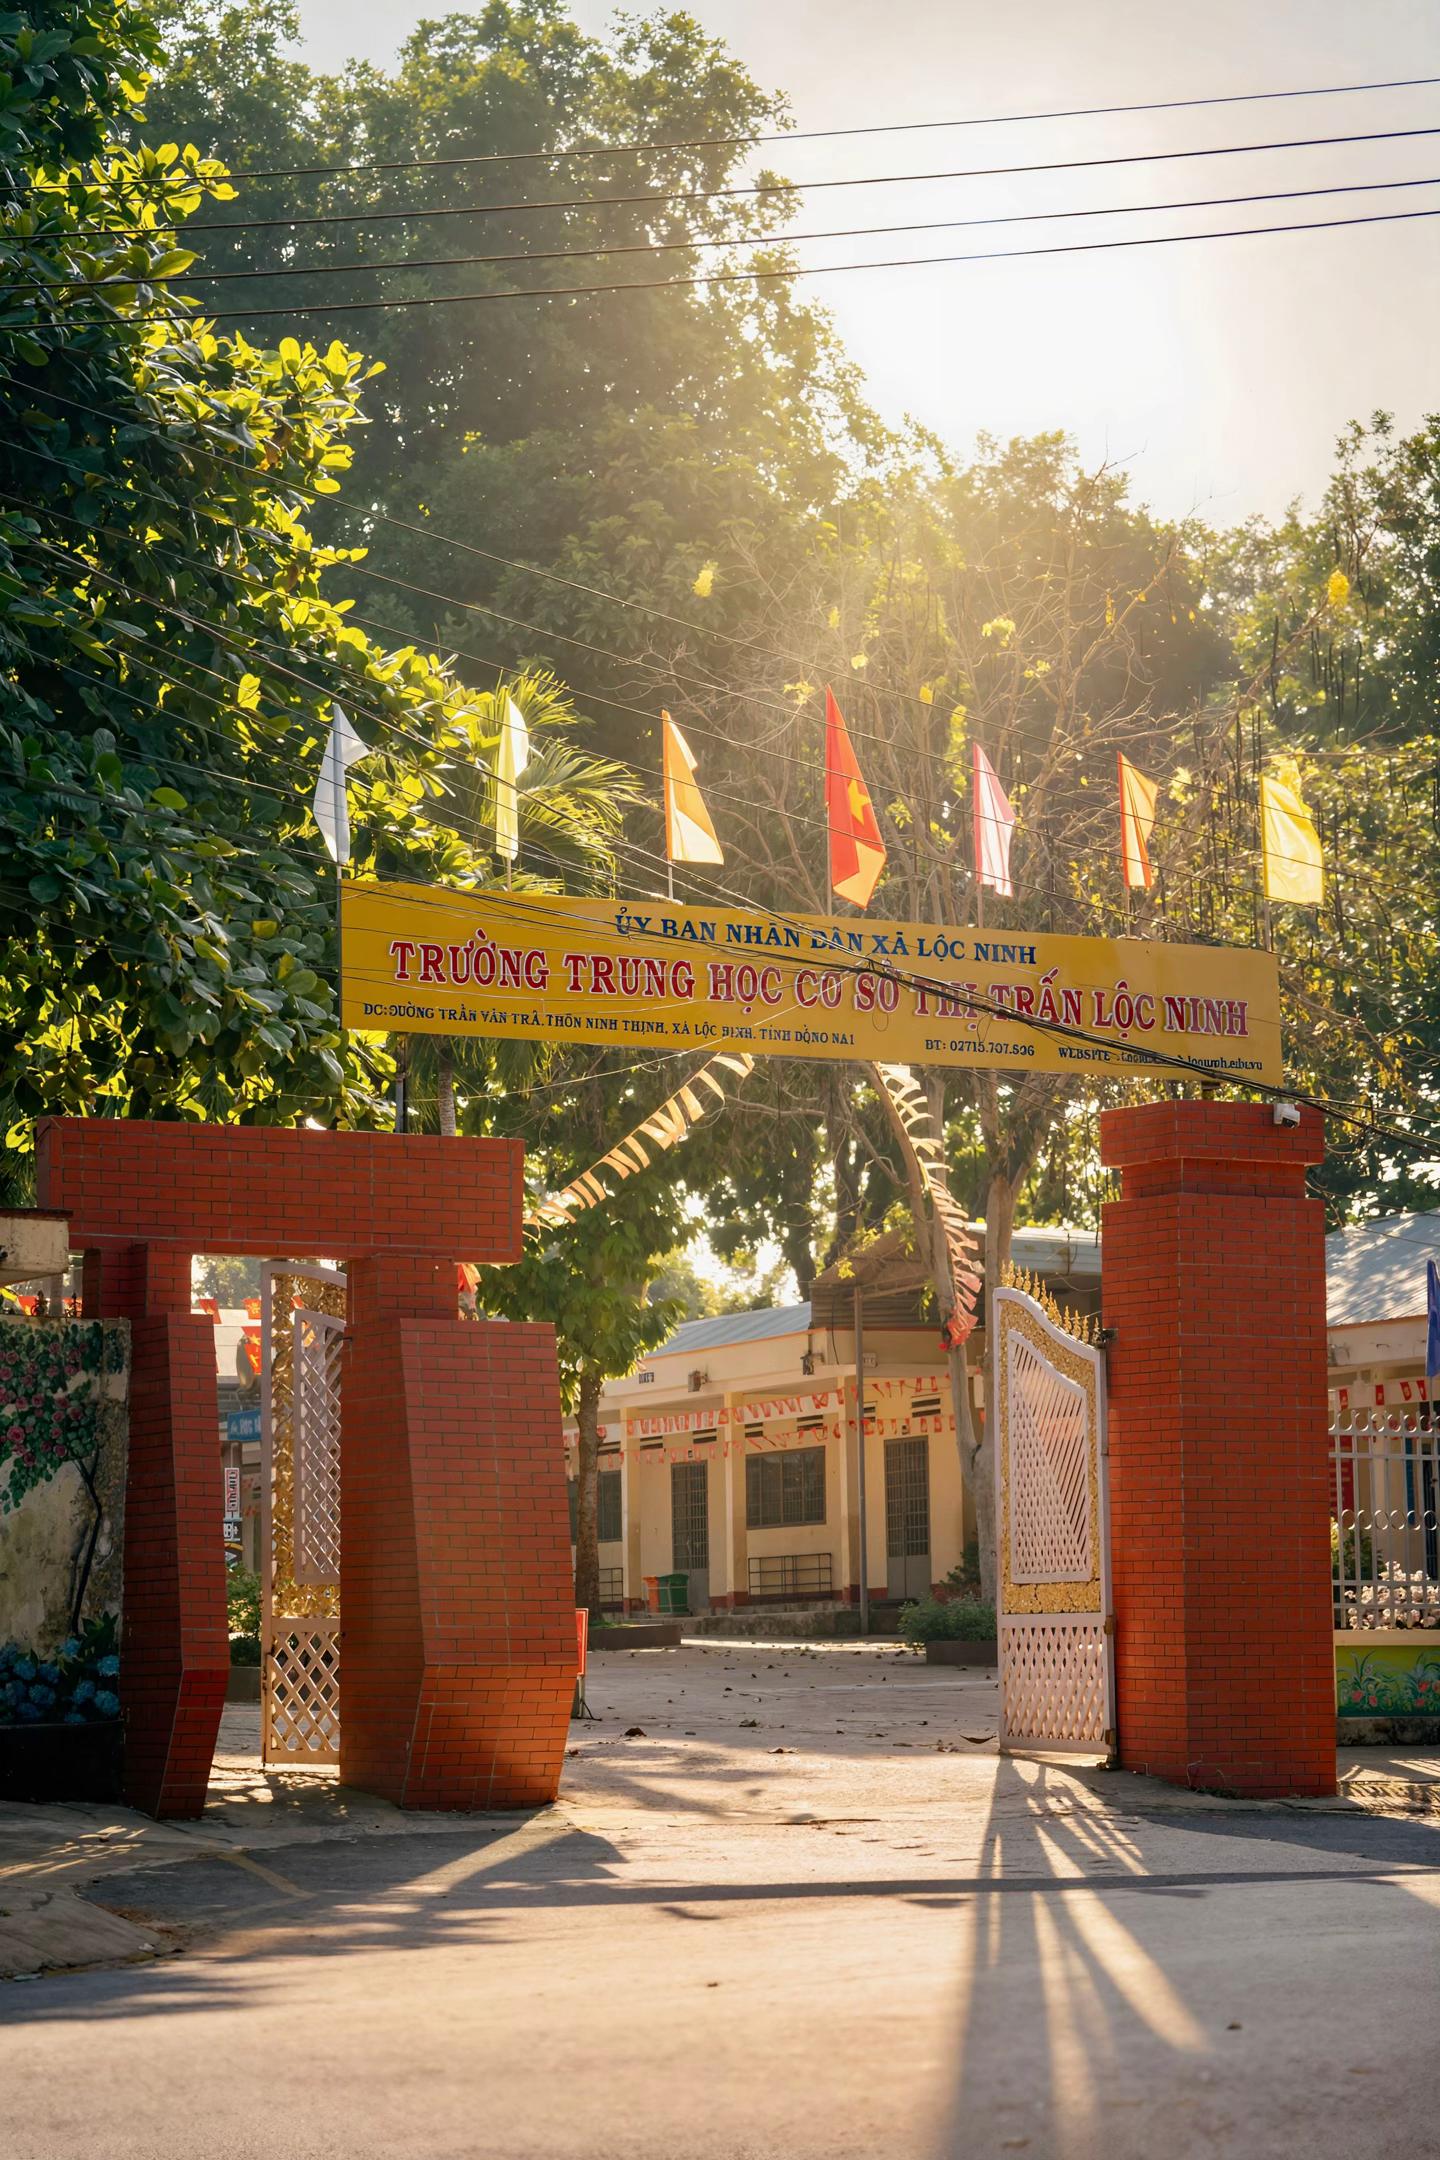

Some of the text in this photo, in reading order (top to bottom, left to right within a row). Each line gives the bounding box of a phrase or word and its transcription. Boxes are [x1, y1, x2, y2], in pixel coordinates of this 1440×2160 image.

[615, 906, 1037, 965] ỦY BAN NHÂN DÂN XÃ LỘC NINH
[389, 928, 551, 990] TRƯỜNG
[563, 953, 696, 999] TRUNG
[707, 962, 783, 1014] HỌC
[911, 976, 979, 1031] THỊ
[989, 967, 1084, 1026] TRẤN
[1091, 980, 1155, 1039] LỘC
[1164, 995, 1249, 1037] NINH
[585, 1017, 618, 1031] NINH
[694, 1021, 717, 1039] LỘC
[832, 1032, 855, 1045] NAI
